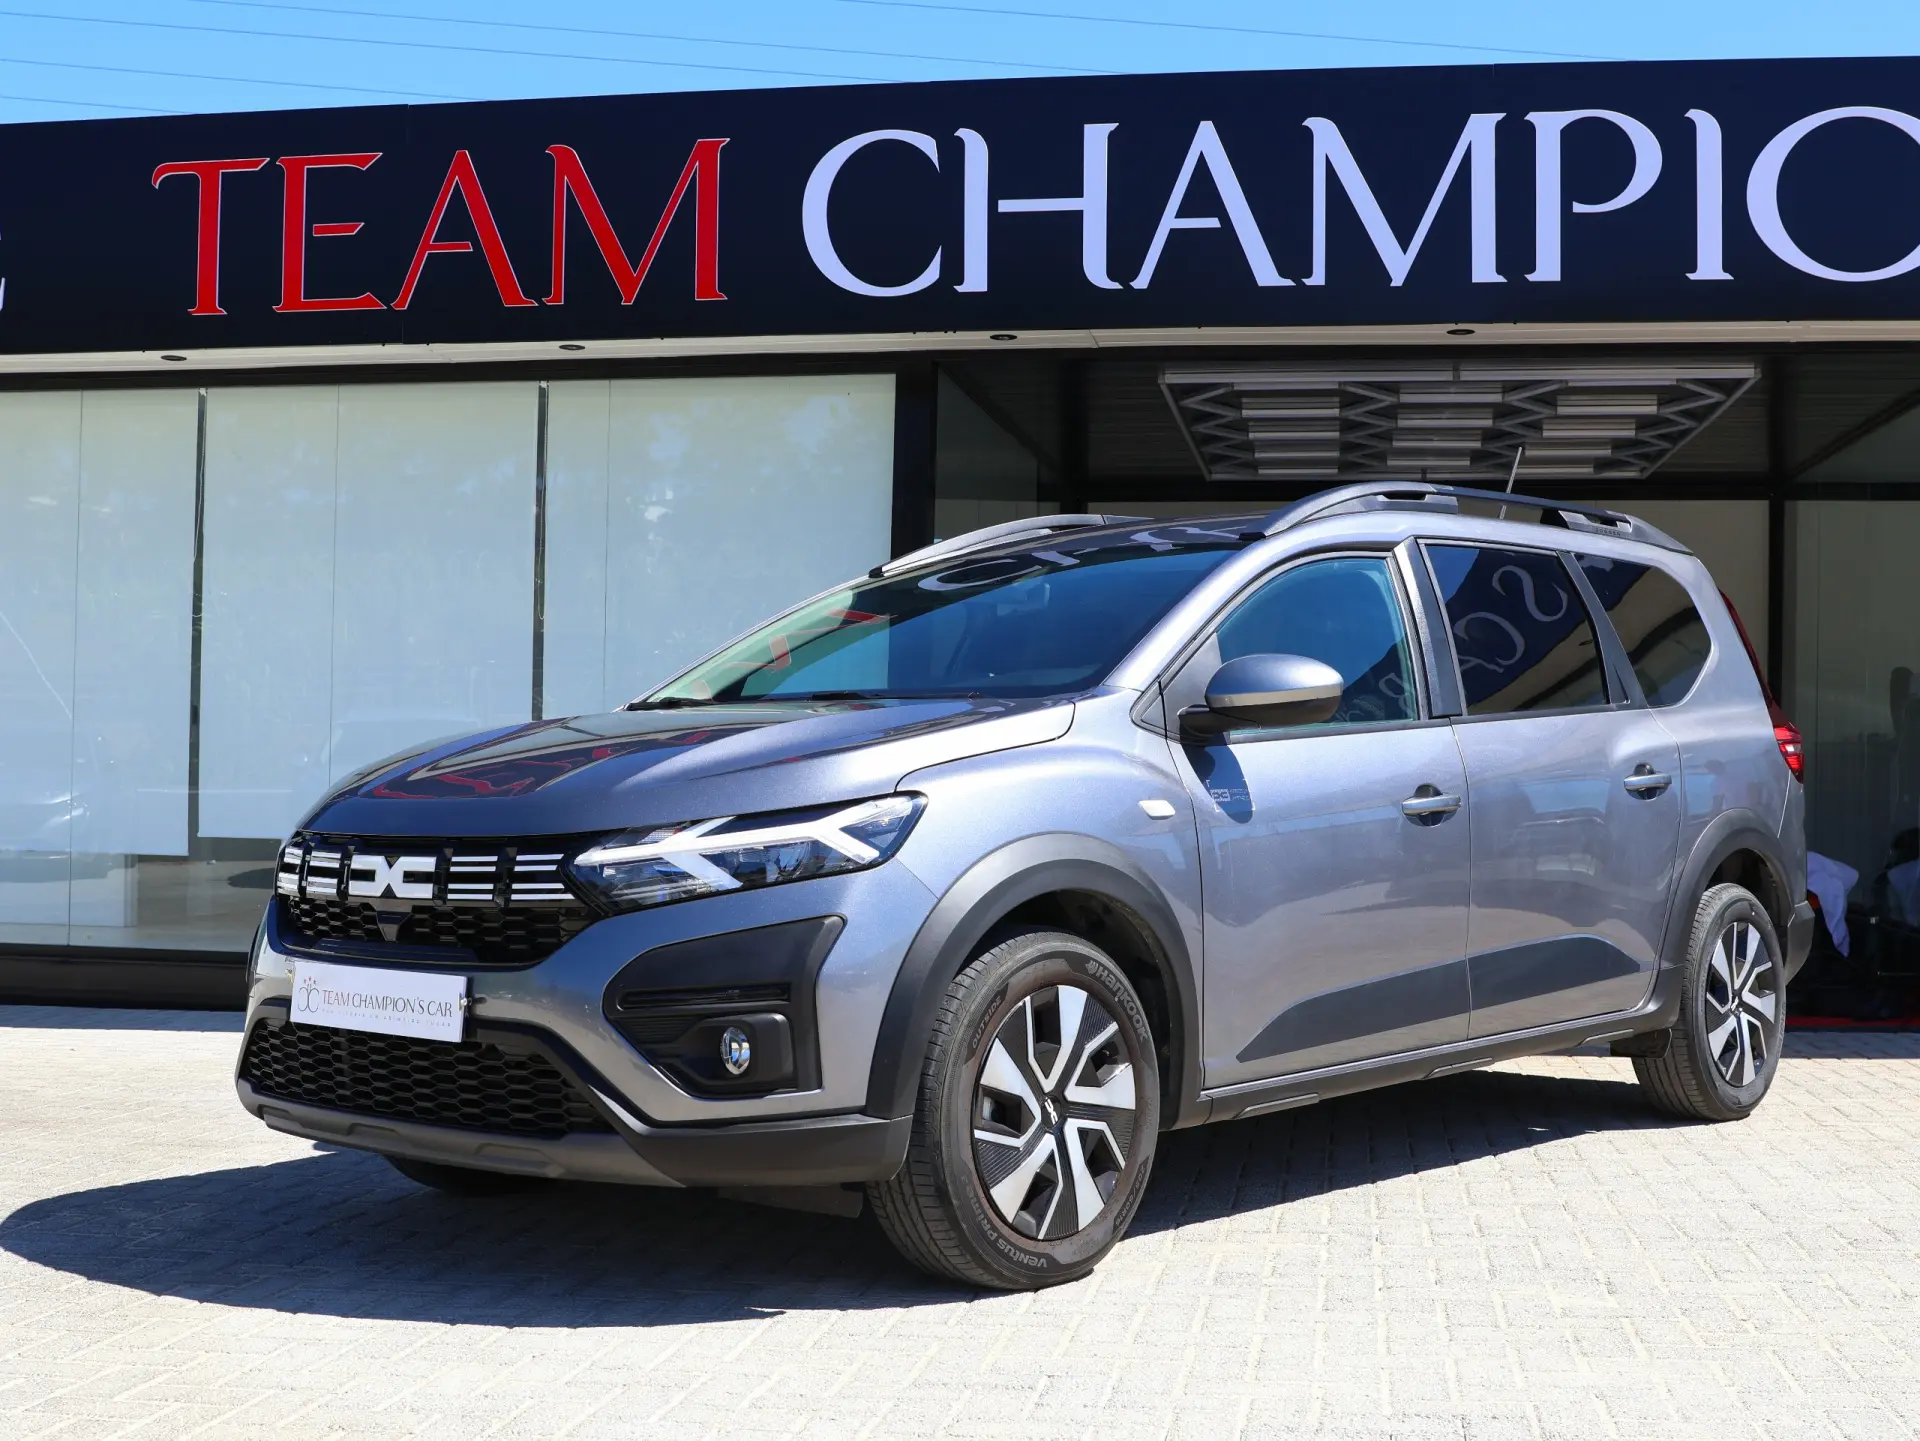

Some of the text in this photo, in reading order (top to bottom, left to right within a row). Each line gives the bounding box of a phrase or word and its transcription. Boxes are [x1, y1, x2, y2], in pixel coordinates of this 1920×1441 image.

[152, 137, 730, 316] TEAM
[322, 989, 350, 1007] TEAM
[352, 992, 425, 1015] CHAMPION'S
[427, 1000, 453, 1018] CAR
[972, 995, 1002, 1049] OUTSIDE
